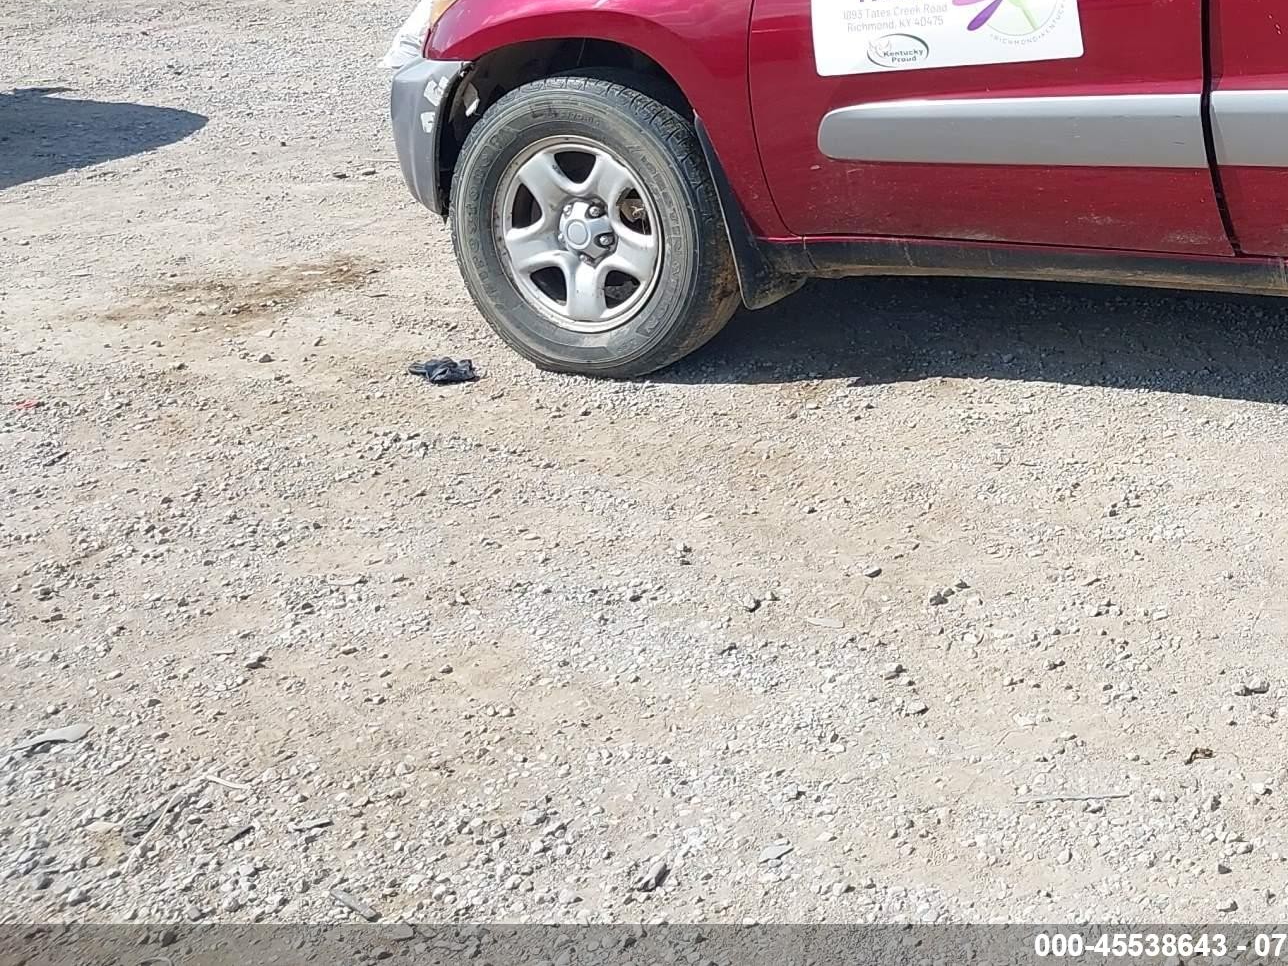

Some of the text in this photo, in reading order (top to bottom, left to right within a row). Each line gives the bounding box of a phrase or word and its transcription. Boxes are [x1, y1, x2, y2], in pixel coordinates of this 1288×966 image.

[866, 8, 892, 19] Tates
[893, 6, 920, 17] Creek
[923, 3, 948, 14] Road
[847, 16, 944, 32] Richmond, KY 40475
[883, 48, 924, 58] Kentucky
